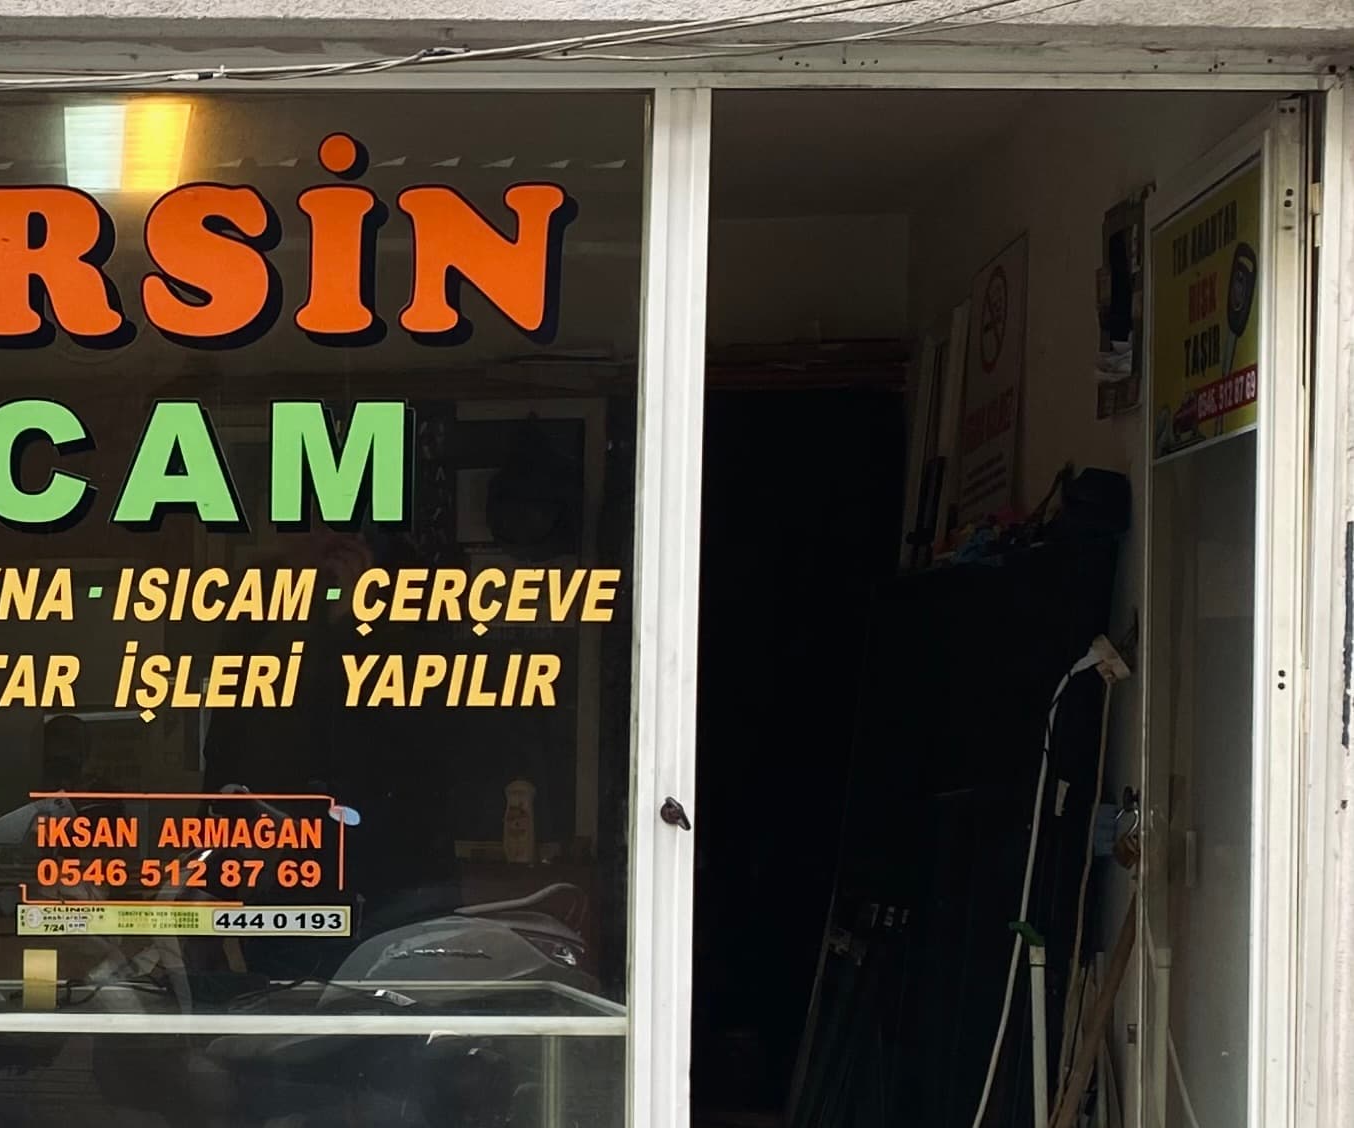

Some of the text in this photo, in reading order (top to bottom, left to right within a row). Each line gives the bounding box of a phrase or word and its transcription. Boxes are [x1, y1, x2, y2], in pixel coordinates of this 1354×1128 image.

[113, 568, 317, 621] ISICAM
[352, 568, 621, 636] ÇERÇEVE
[114, 641, 304, 723] İŞLERİ
[342, 654, 561, 707] YAPILIR
[37, 859, 321, 888] 0546 512 87 69
[44, 924, 65, 932] 7/24
[215, 913, 342, 930] 444 0 193
